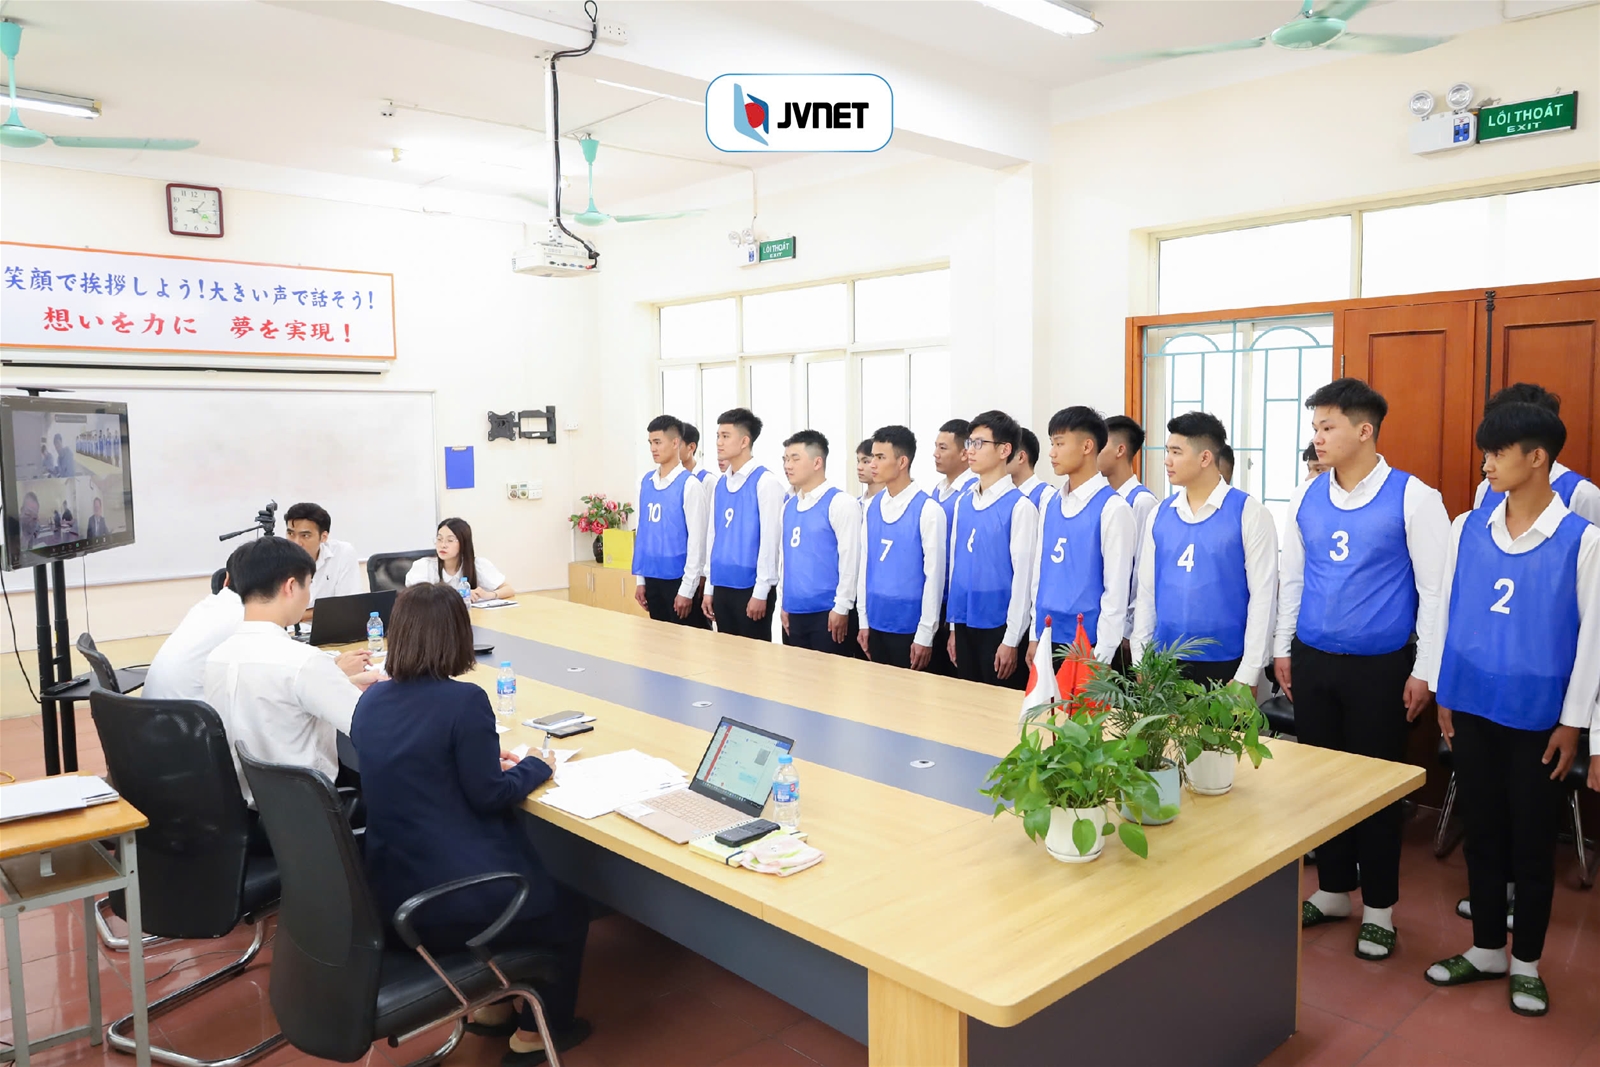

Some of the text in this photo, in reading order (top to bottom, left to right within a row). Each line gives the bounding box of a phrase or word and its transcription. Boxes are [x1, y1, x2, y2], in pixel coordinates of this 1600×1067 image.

[1488, 102, 1564, 127] LỐI THOÁT
[1507, 121, 1542, 133] EXIT
[43, 306, 197, 336] 想いを力に
[647, 502, 661, 523] 10
[724, 507, 734, 528] 9
[790, 526, 801, 548] 8
[1329, 530, 1349, 562] 3
[879, 538, 893, 562] 7
[1050, 537, 1067, 564] 5
[1177, 543, 1195, 573] 4
[1490, 578, 1515, 615] 2
